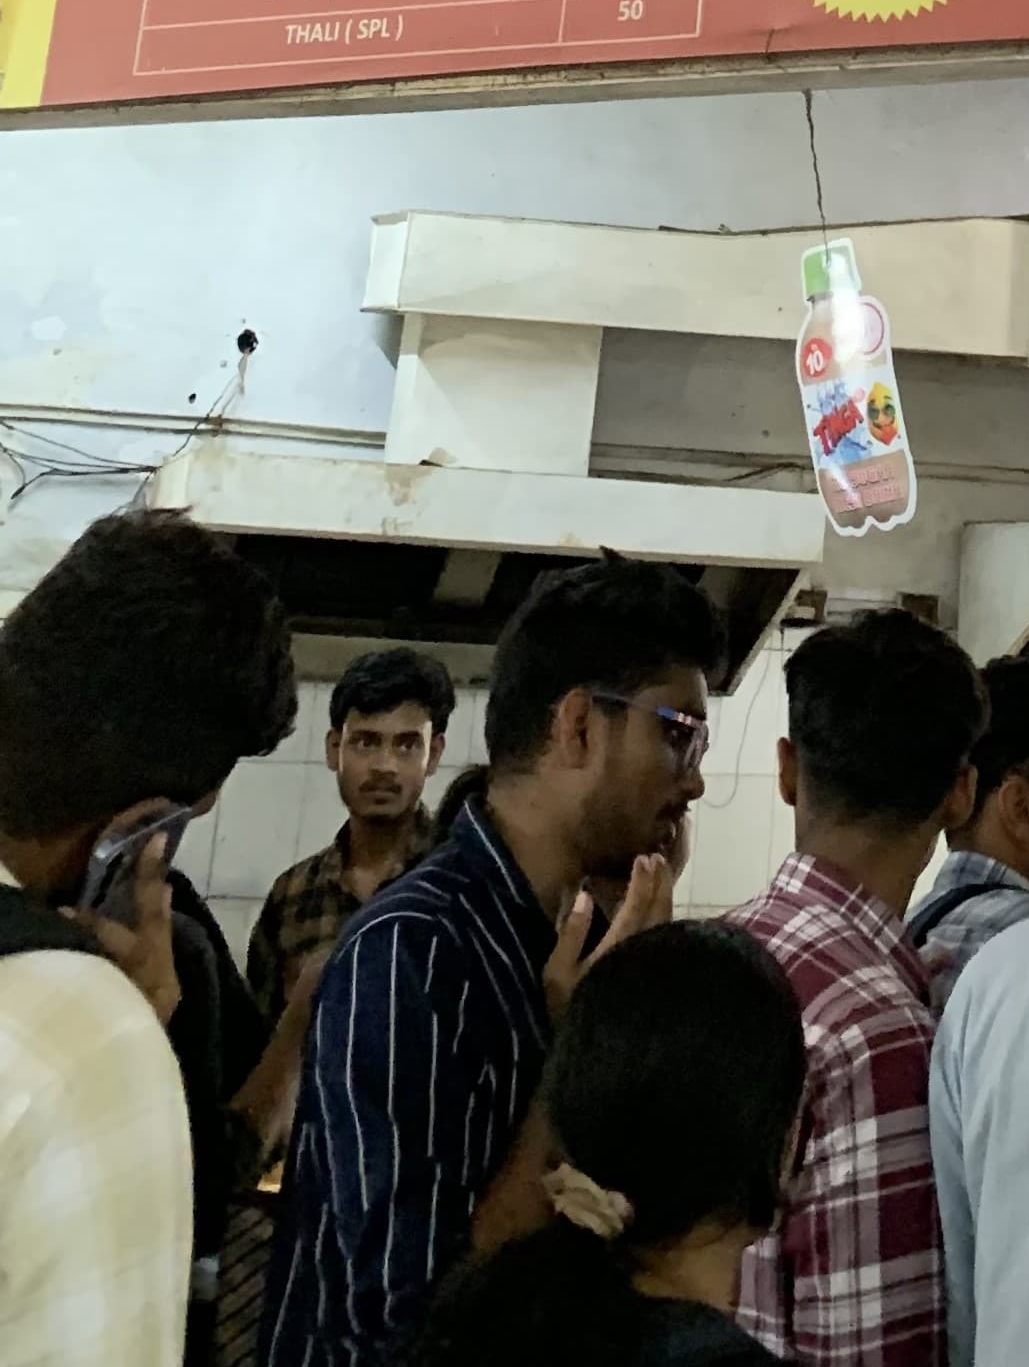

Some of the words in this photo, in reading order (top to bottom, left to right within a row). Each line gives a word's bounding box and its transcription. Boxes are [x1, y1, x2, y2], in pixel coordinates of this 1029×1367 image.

[618, 0, 643, 20] 50
[286, 22, 339, 44] THALI
[357, 18, 390, 39] SPL
